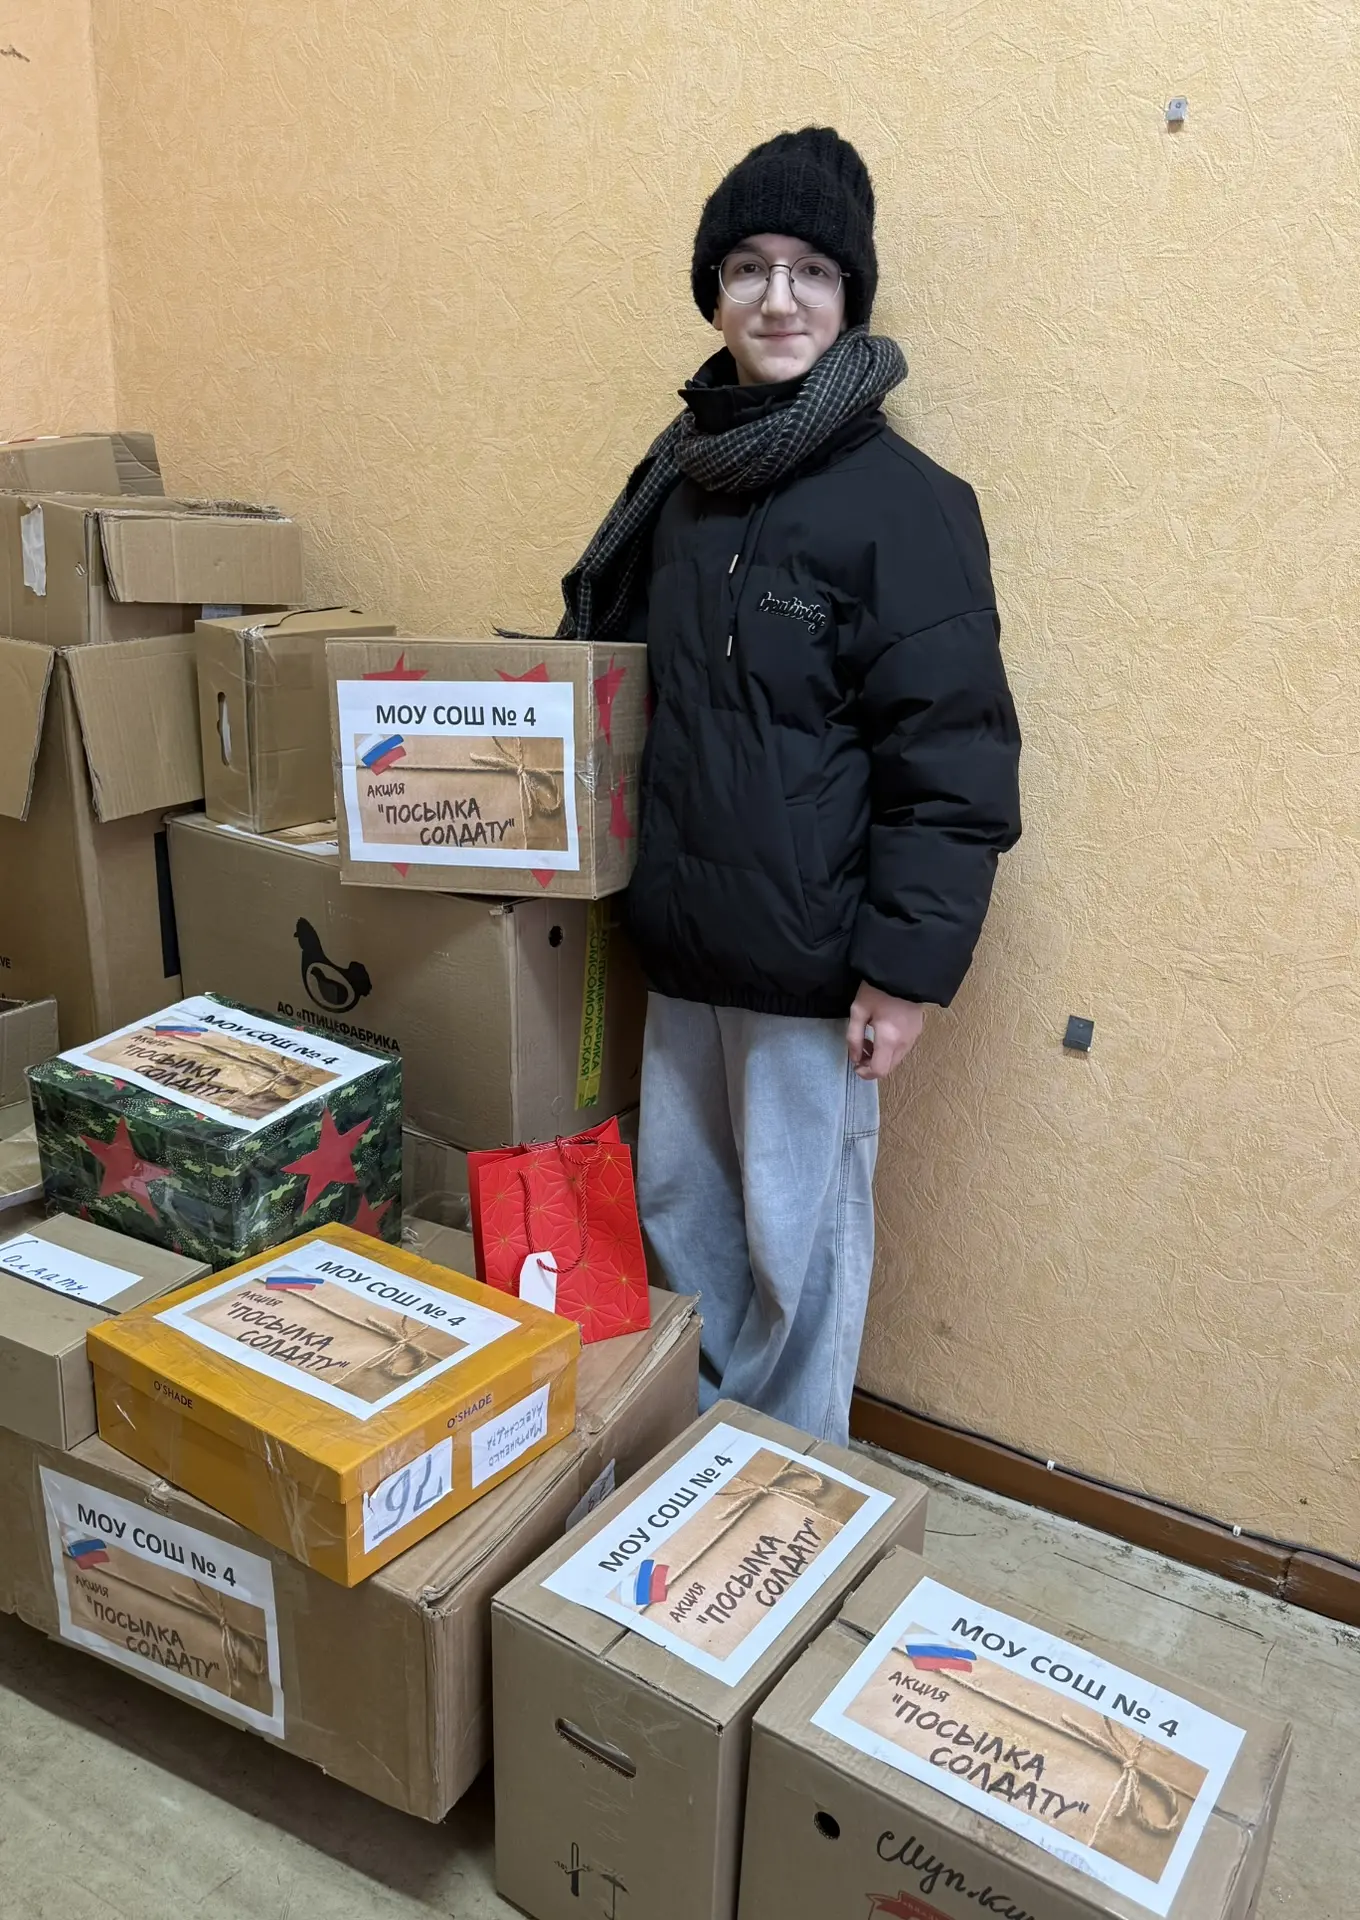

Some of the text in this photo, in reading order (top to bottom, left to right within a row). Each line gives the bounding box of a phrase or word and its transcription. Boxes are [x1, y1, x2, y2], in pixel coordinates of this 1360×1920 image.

[376, 704, 537, 727] МОУ СОШ № 4
[367, 782, 406, 798] АКЦИЯ
[377, 797, 481, 825] "ПОСЫЛКА
[419, 818, 515, 848] СОЛДАТУ"
[277, 1001, 294, 1017] АО
[130, 1035, 174, 1048] АКЦИЯ
[198, 1014, 340, 1065] МОУ СОШ № 4
[236, 1288, 285, 1309] АКЦИЯ
[314, 1260, 468, 1328] МОУ СОШ № 4
[226, 1301, 336, 1351] "ПОСЫЛКА
[236, 1329, 351, 1371] СОЛДАТУ"
[153, 1379, 194, 1410] O'SHADE
[446, 1392, 493, 1430] O'SHADE
[598, 1526, 652, 1573] МОУ
[647, 1484, 699, 1529] СОШ
[689, 1466, 722, 1493] №
[713, 1453, 733, 1469] 4
[76, 1502, 236, 1587] МОУ СОШ № 4
[755, 1516, 823, 1608] СОЛДАТУ"
[75, 1574, 110, 1598] АКЦИЯ
[695, 1533, 787, 1626] "ПОСЫЛКА
[86, 1595, 184, 1650] "ПОСЫЛКА
[668, 1581, 708, 1624] АКЦИЯ
[125, 1635, 221, 1680] СОЛДАТУ"
[949, 1616, 1181, 1739] МОУ СОШ № 4
[887, 1670, 951, 1703] АКЦИЯ
[891, 1691, 1047, 1782] "ПОСЫЛКА
[928, 1745, 1090, 1820] СОЛДАТУ"
